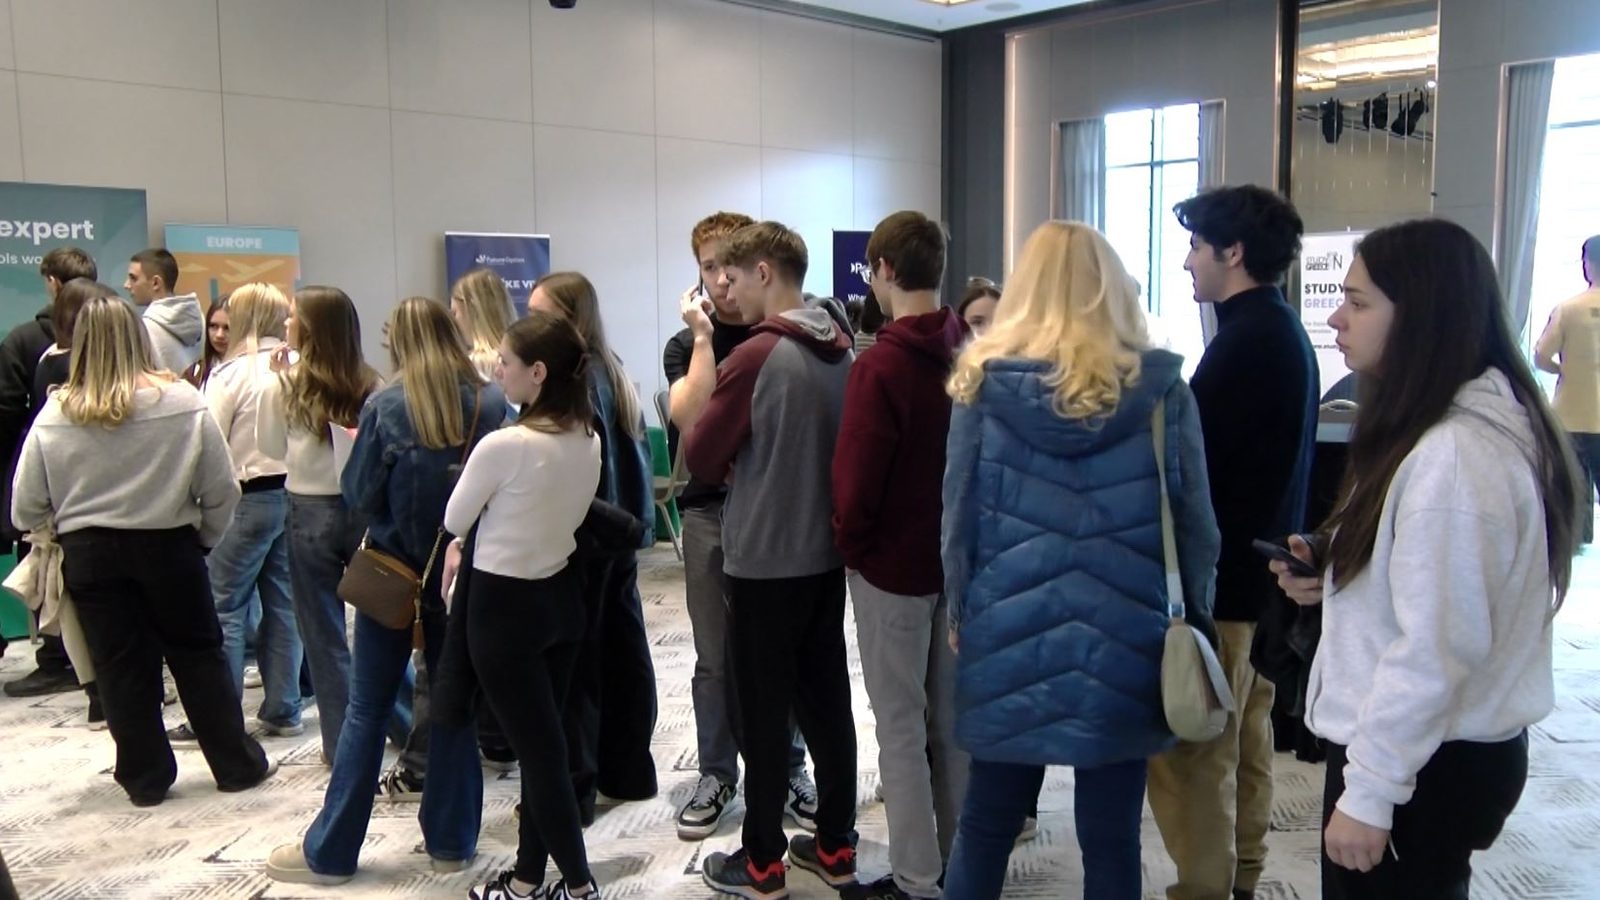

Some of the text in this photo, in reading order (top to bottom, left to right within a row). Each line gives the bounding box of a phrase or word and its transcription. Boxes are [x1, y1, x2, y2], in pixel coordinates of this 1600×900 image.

[0, 220, 94, 245] expert
[206, 236, 263, 249] EUROPE
[1304, 283, 1344, 295] STUDY
